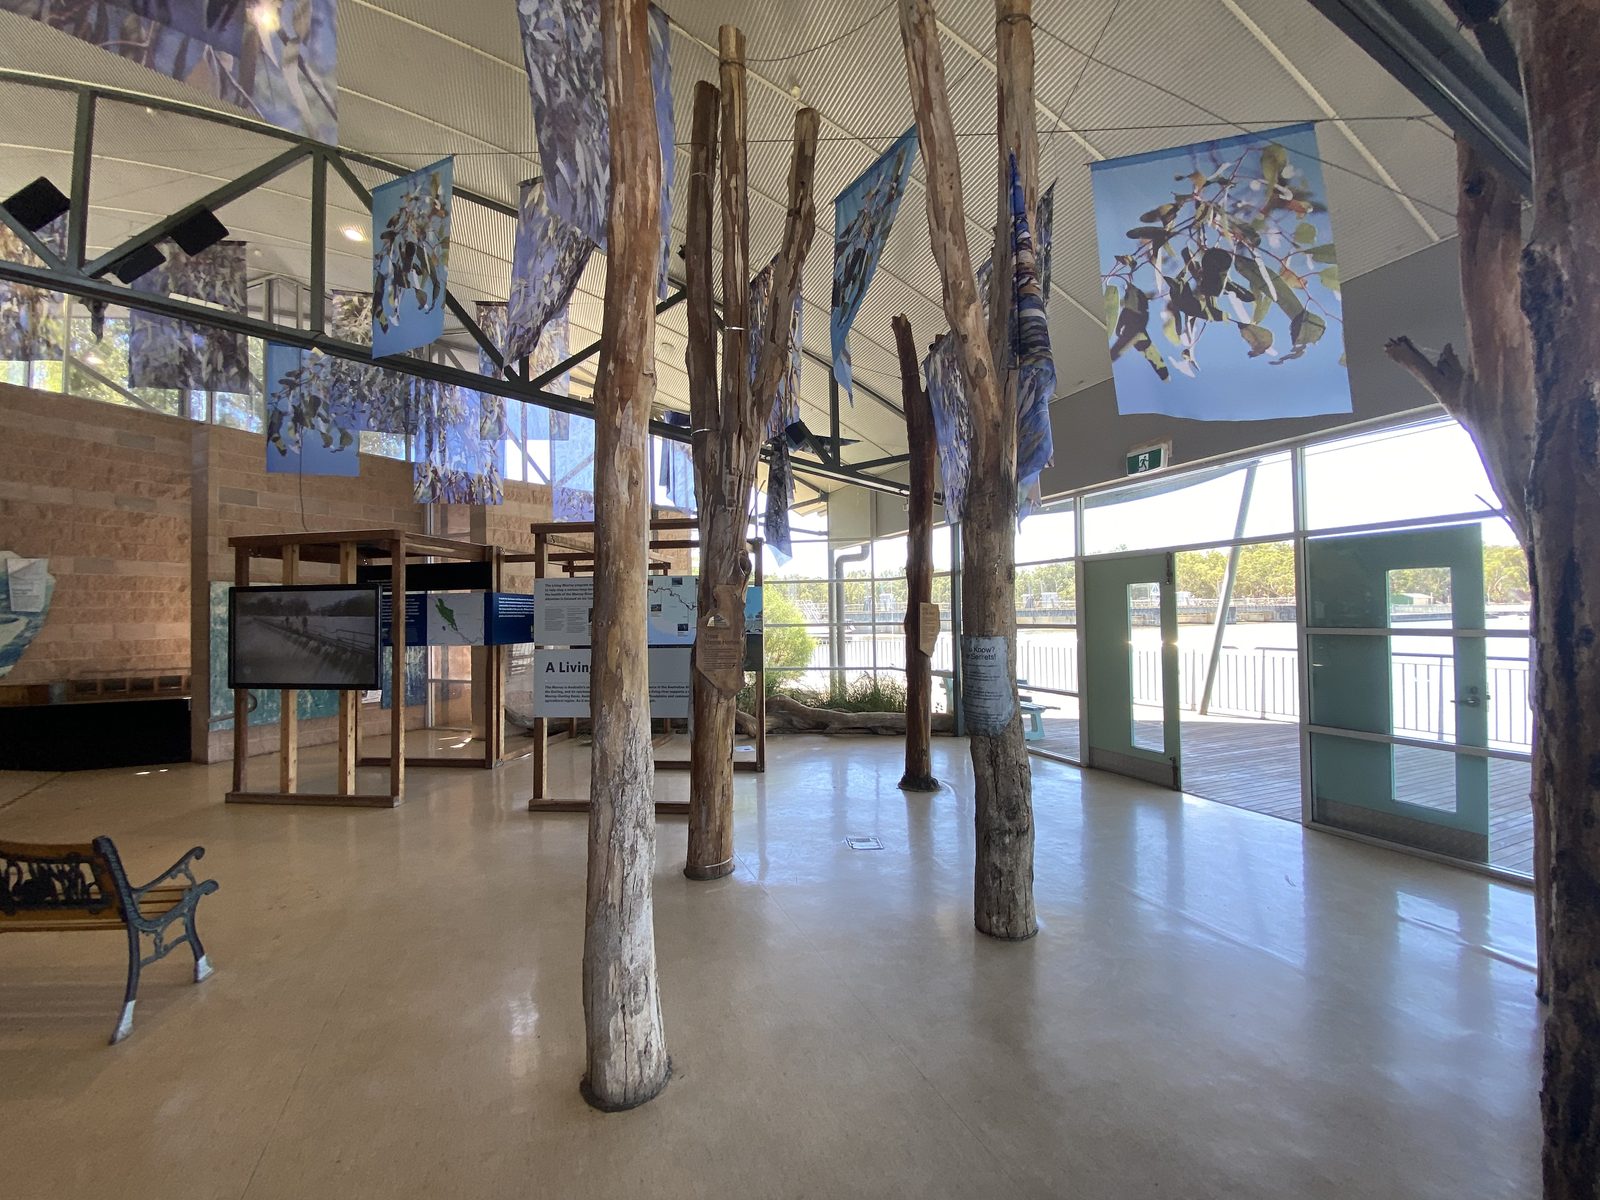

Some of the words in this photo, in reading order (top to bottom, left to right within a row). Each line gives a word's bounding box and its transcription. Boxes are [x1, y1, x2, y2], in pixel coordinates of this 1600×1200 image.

[974, 646, 995, 654] Know?
[546, 662, 555, 673] A
[559, 661, 591, 674] Livin
